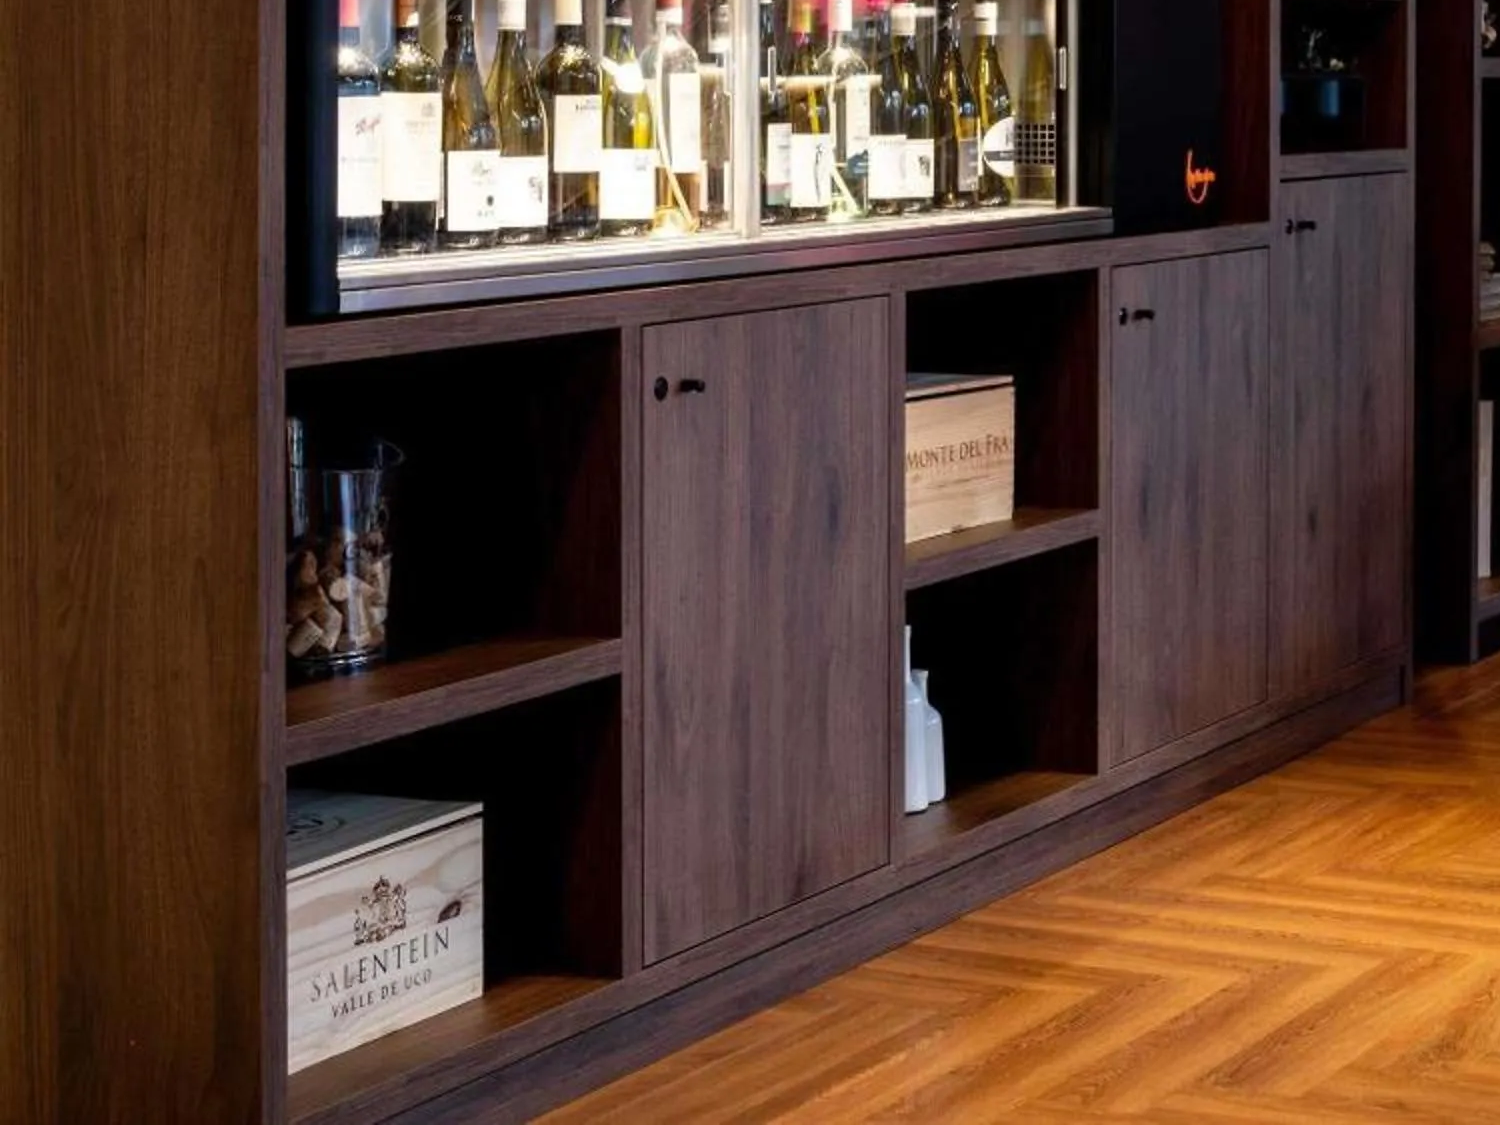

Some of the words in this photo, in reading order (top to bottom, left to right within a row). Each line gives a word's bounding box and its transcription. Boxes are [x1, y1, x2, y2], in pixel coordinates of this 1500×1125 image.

[907, 445, 955, 468] MONTE
[959, 439, 982, 460] DEL
[310, 926, 449, 1002] SALENTEIN
[331, 990, 374, 1018] VALLE
[380, 981, 398, 1000] DE
[403, 968, 432, 990] UCO
